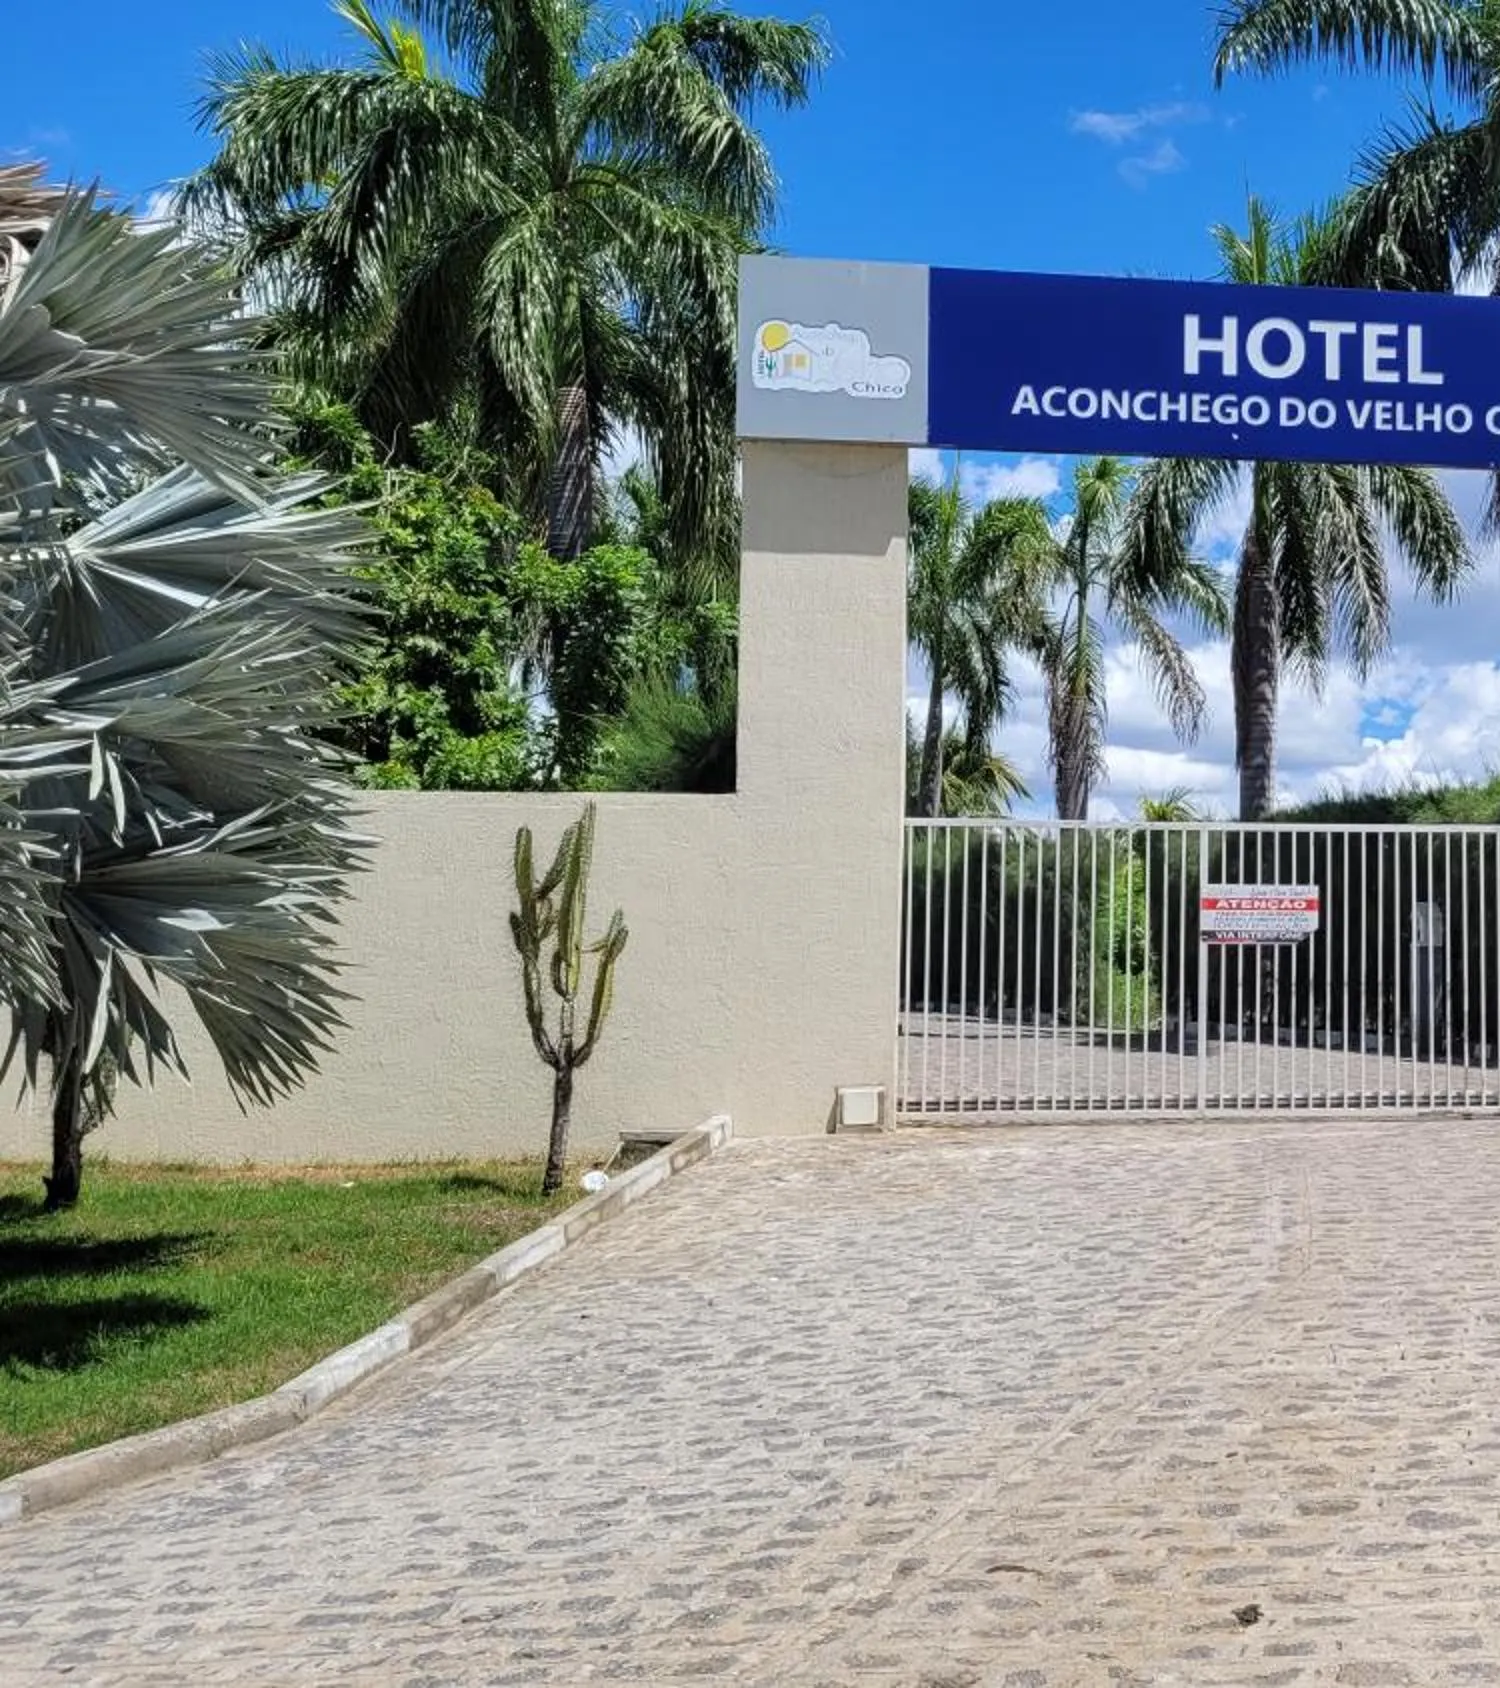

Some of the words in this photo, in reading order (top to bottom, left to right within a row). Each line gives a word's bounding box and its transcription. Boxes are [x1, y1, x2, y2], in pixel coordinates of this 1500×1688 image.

[1184, 315, 1443, 385] HOTEL
[1011, 385, 1270, 426] ACONCHEGO
[1279, 398, 1337, 429] DO
[1346, 401, 1473, 433] VELHO
